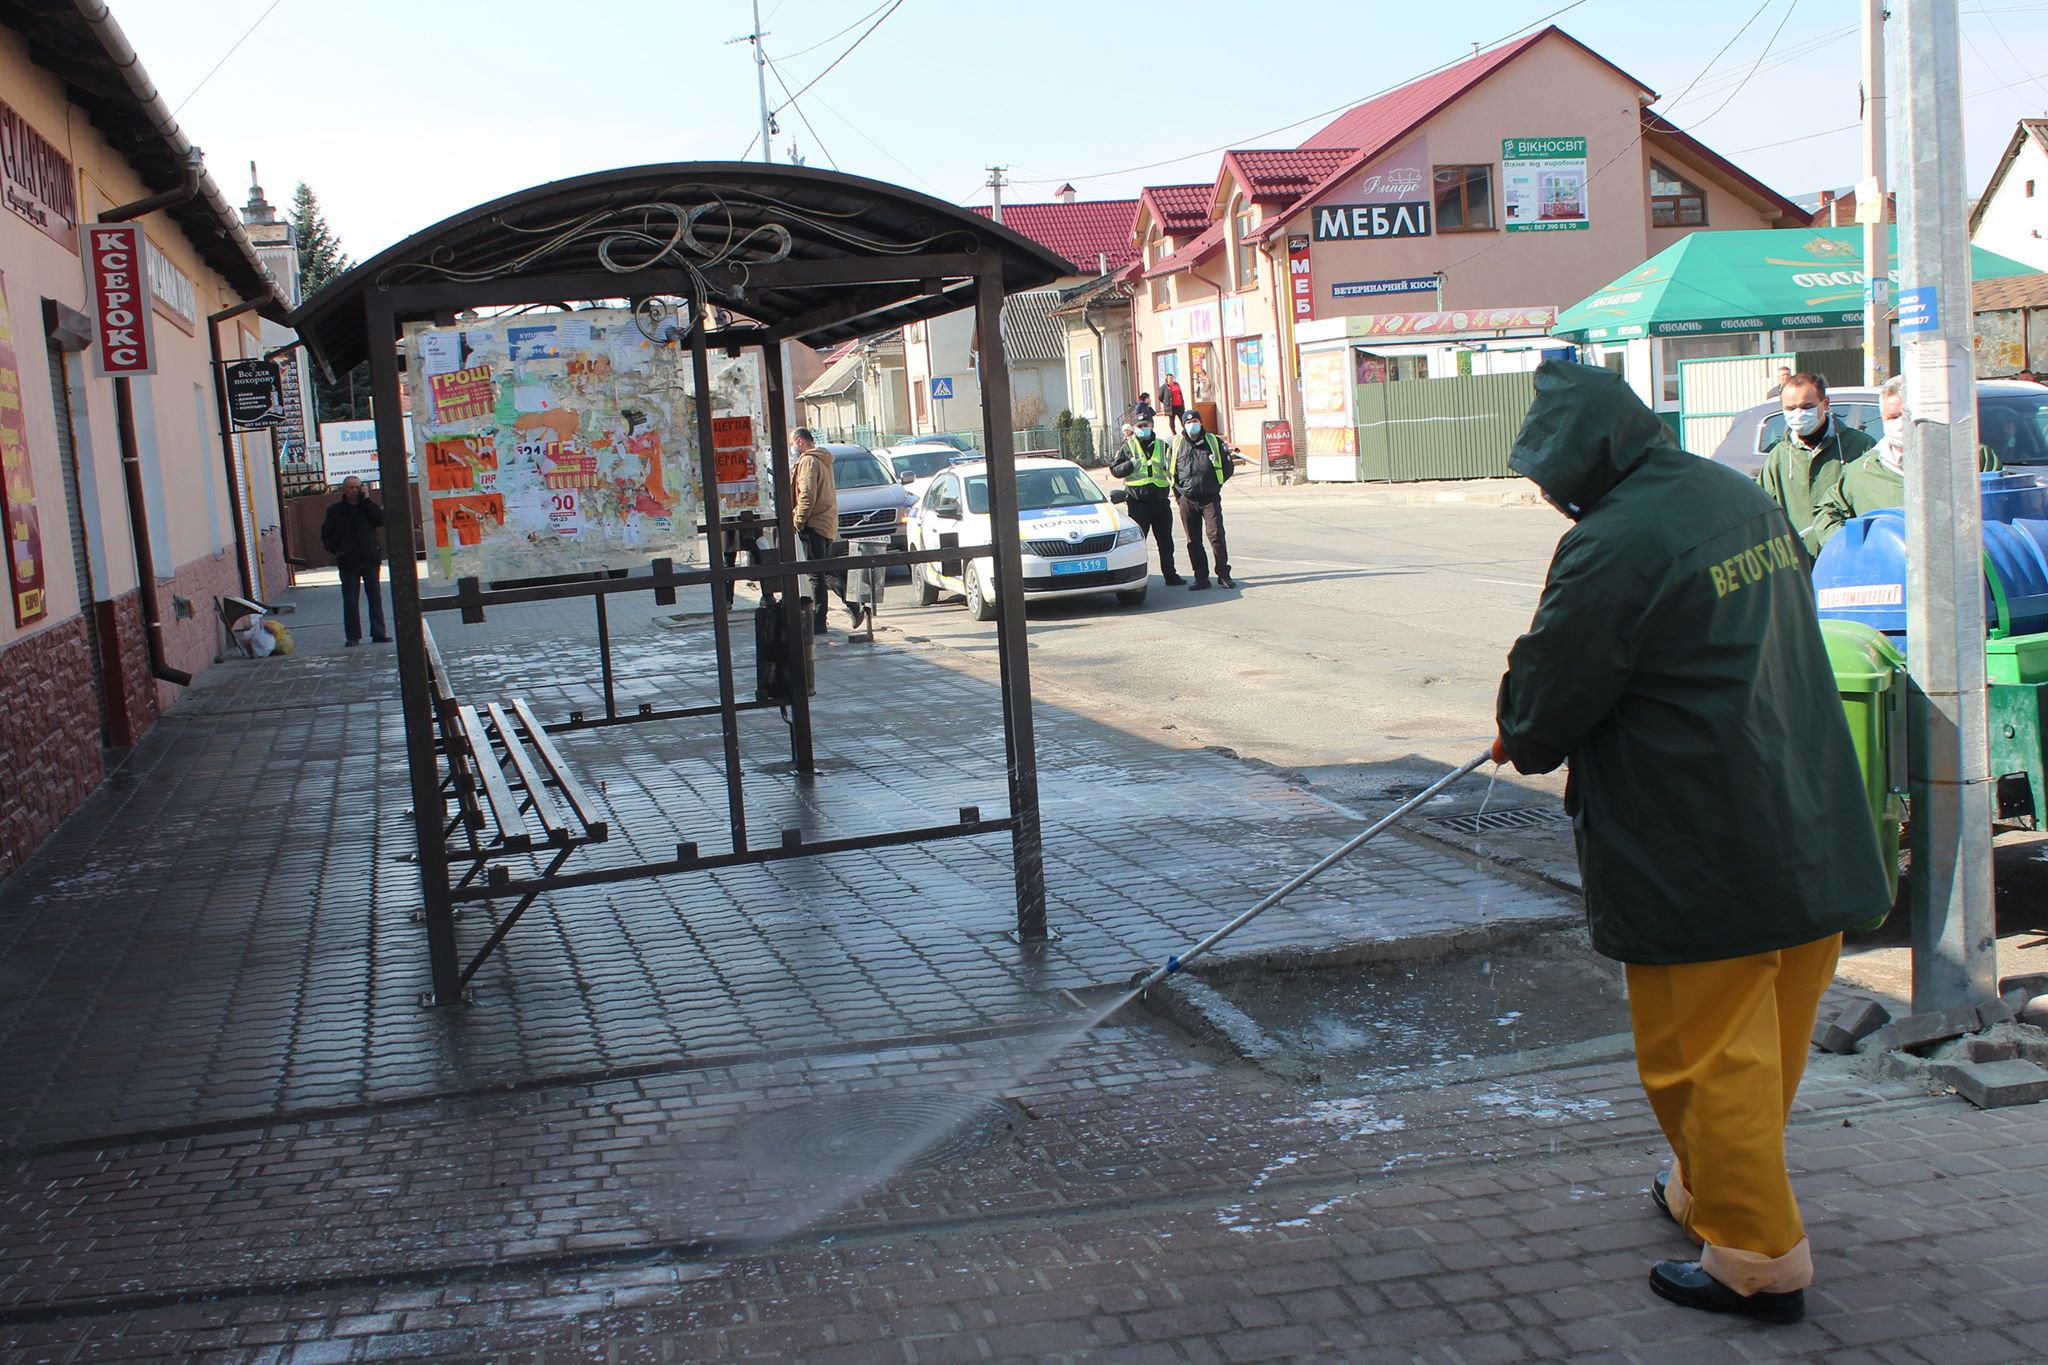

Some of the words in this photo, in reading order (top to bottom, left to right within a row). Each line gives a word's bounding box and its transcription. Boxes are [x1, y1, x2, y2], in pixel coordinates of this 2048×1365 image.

[1518, 140, 1584, 152] ВІКНОСВІТ
[1319, 205, 1426, 238] МЕБЛІ
[1291, 259, 1312, 323] МЕБ
[1333, 280, 1408, 296] ВЕТЕРИНАРНИЙ
[97, 233, 139, 365] КСЕРОКС
[1659, 322, 1702, 333] ОБОЛОНЬ
[1720, 319, 1763, 329] ОБОЛОНЬ
[1781, 315, 1823, 325] ОБОЛОНЬ
[234, 375, 275, 385] похорону
[238, 370, 253, 378] Все
[714, 421, 750, 432] ЦЕГЛА
[1266, 431, 1290, 440] МЕБЛІ
[717, 455, 744, 465] ЕГЛА
[1033, 518, 1100, 530] ПОЛІЦІЯ
[1078, 559, 1101, 571] 1319
